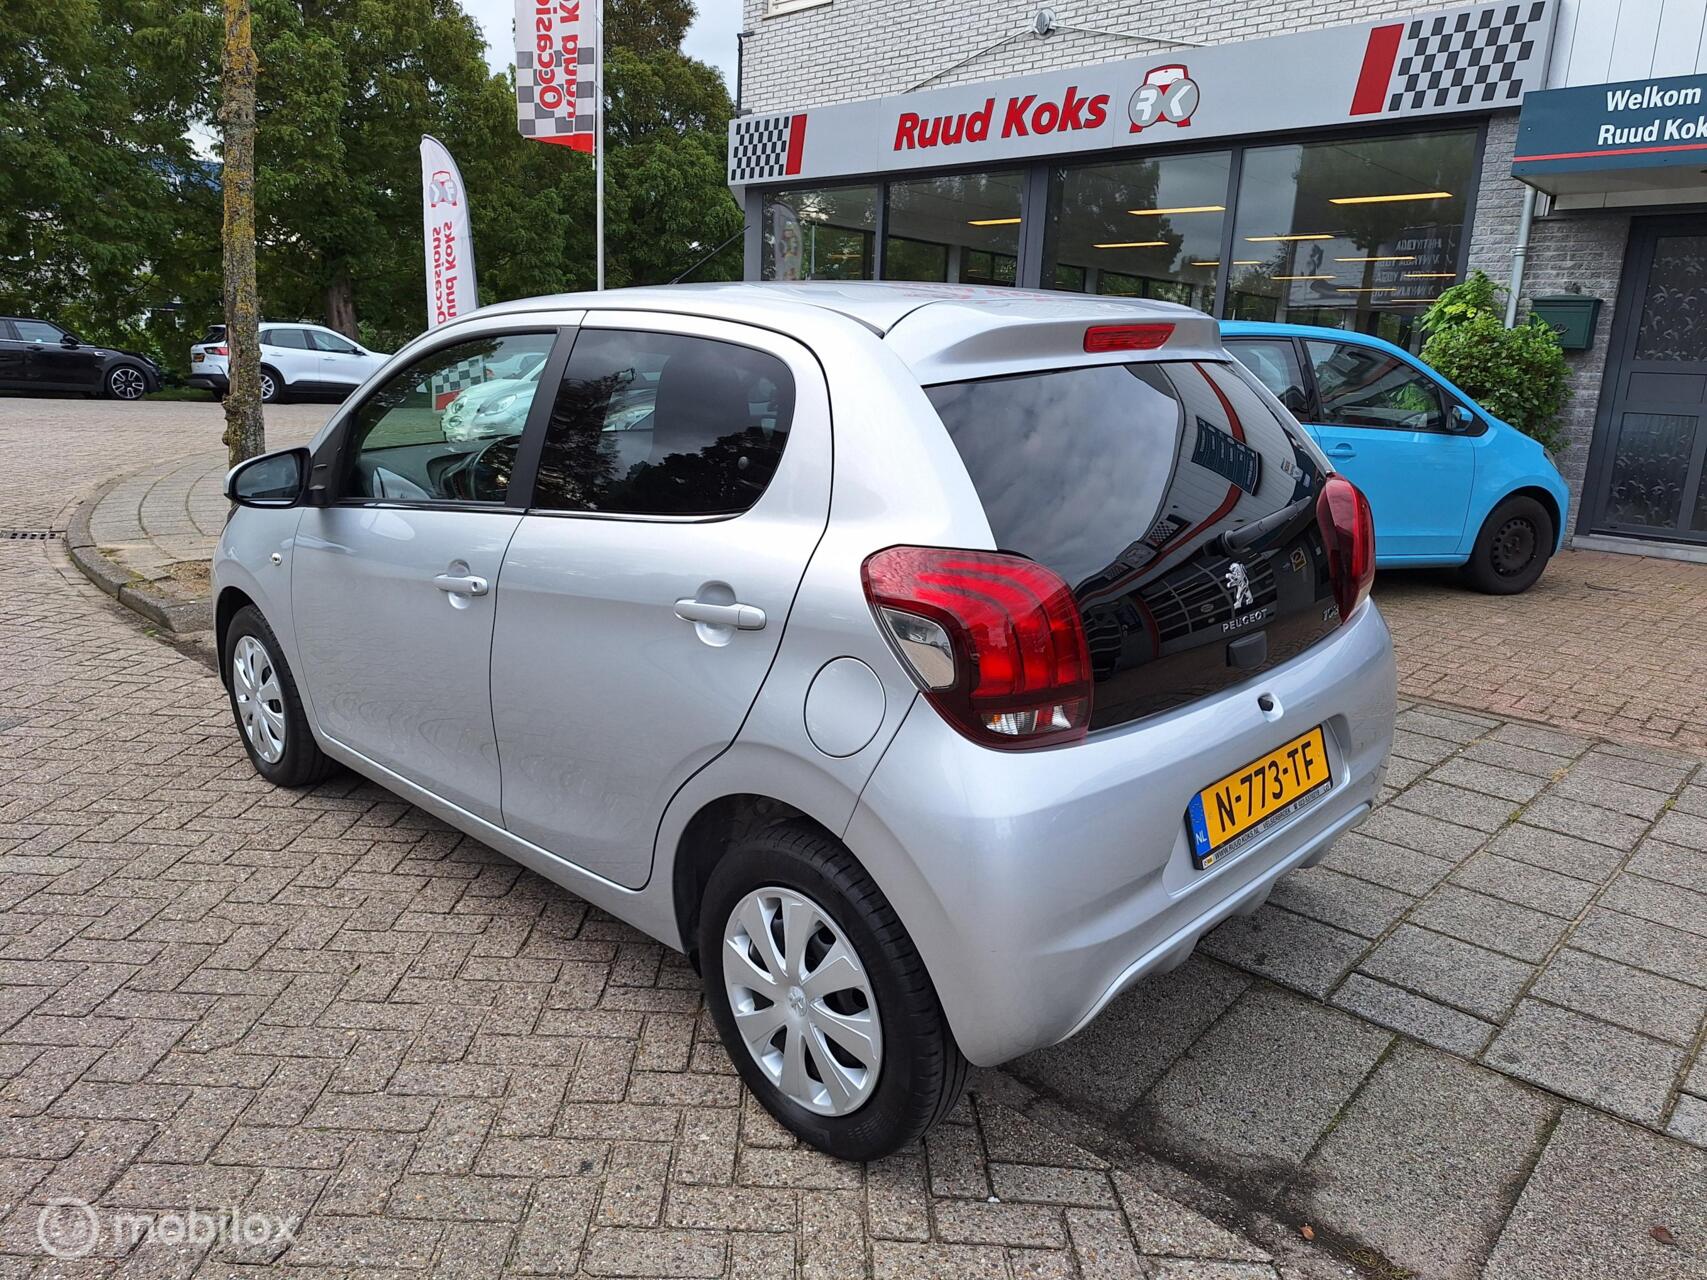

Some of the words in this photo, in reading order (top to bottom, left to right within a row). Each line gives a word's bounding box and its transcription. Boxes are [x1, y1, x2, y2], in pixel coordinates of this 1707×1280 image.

[1607, 86, 1702, 112] Welkom
[893, 98, 996, 151] Ruud
[1001, 86, 1111, 138] Koks
[1597, 119, 1660, 146] Ruud
[1222, 608, 1268, 633] PEUGEOT
[1215, 740, 1314, 833] N-773-TF
[1195, 830, 1207, 845] NL
